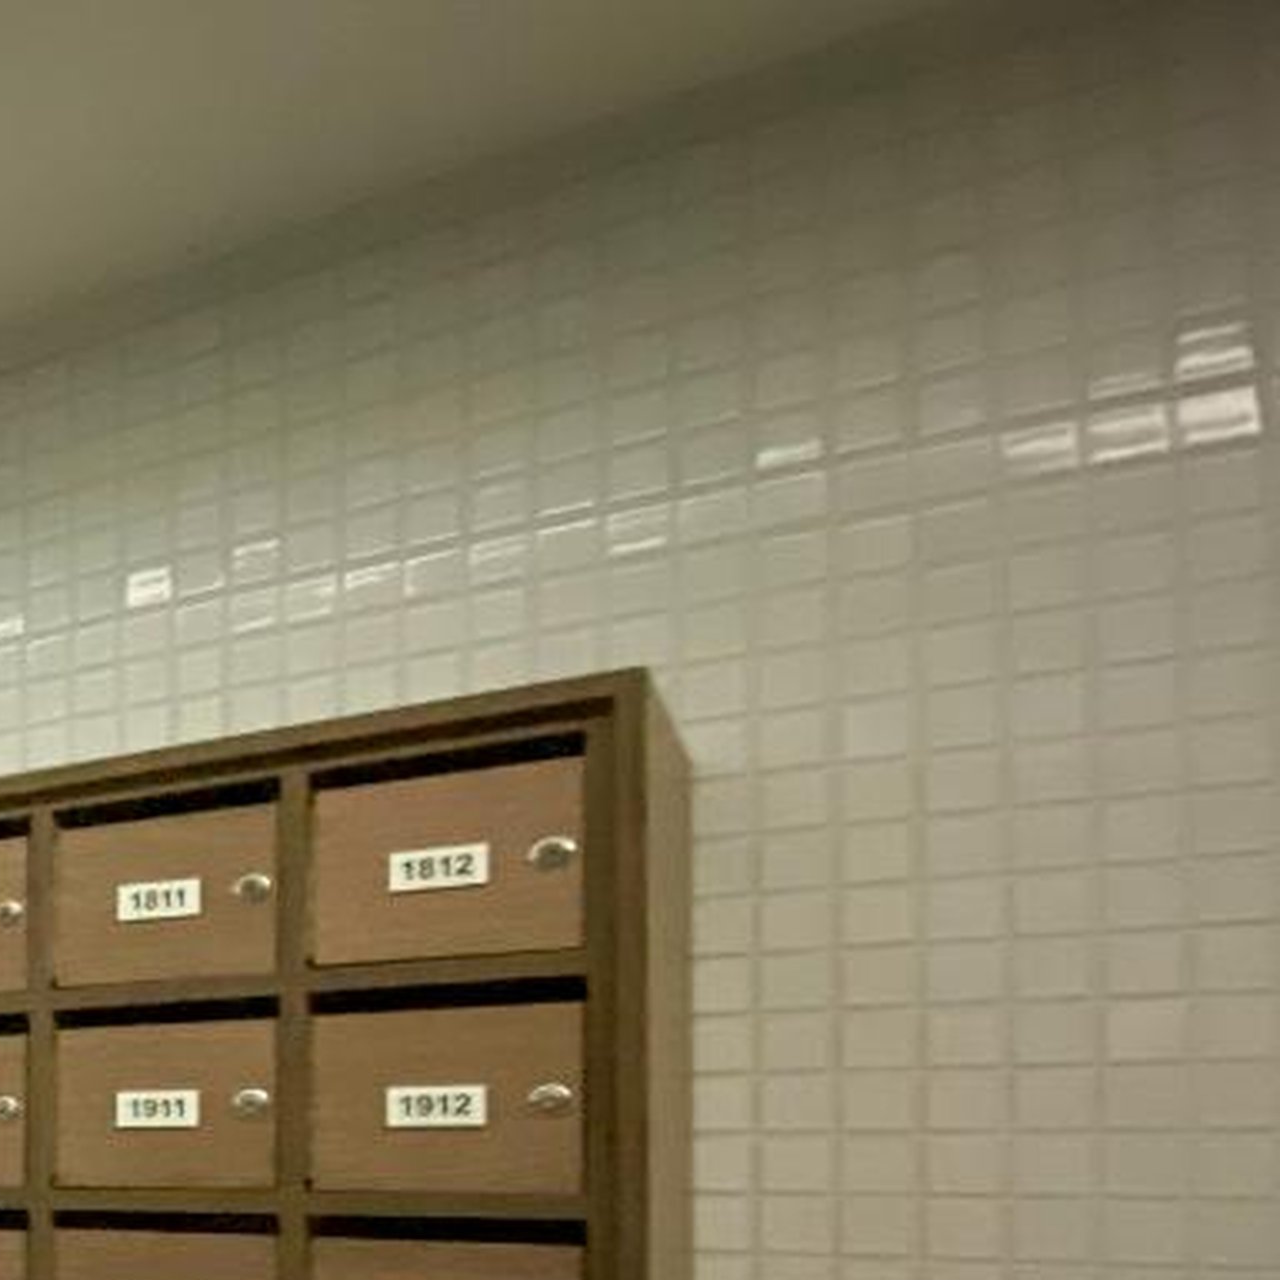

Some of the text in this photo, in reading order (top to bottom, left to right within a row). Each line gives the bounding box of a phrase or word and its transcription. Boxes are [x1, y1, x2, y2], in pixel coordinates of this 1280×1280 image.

[402, 853, 474, 881] 1812
[130, 888, 186, 910] 1811
[130, 1097, 186, 1118] 1911
[399, 1094, 472, 1117] 1912
